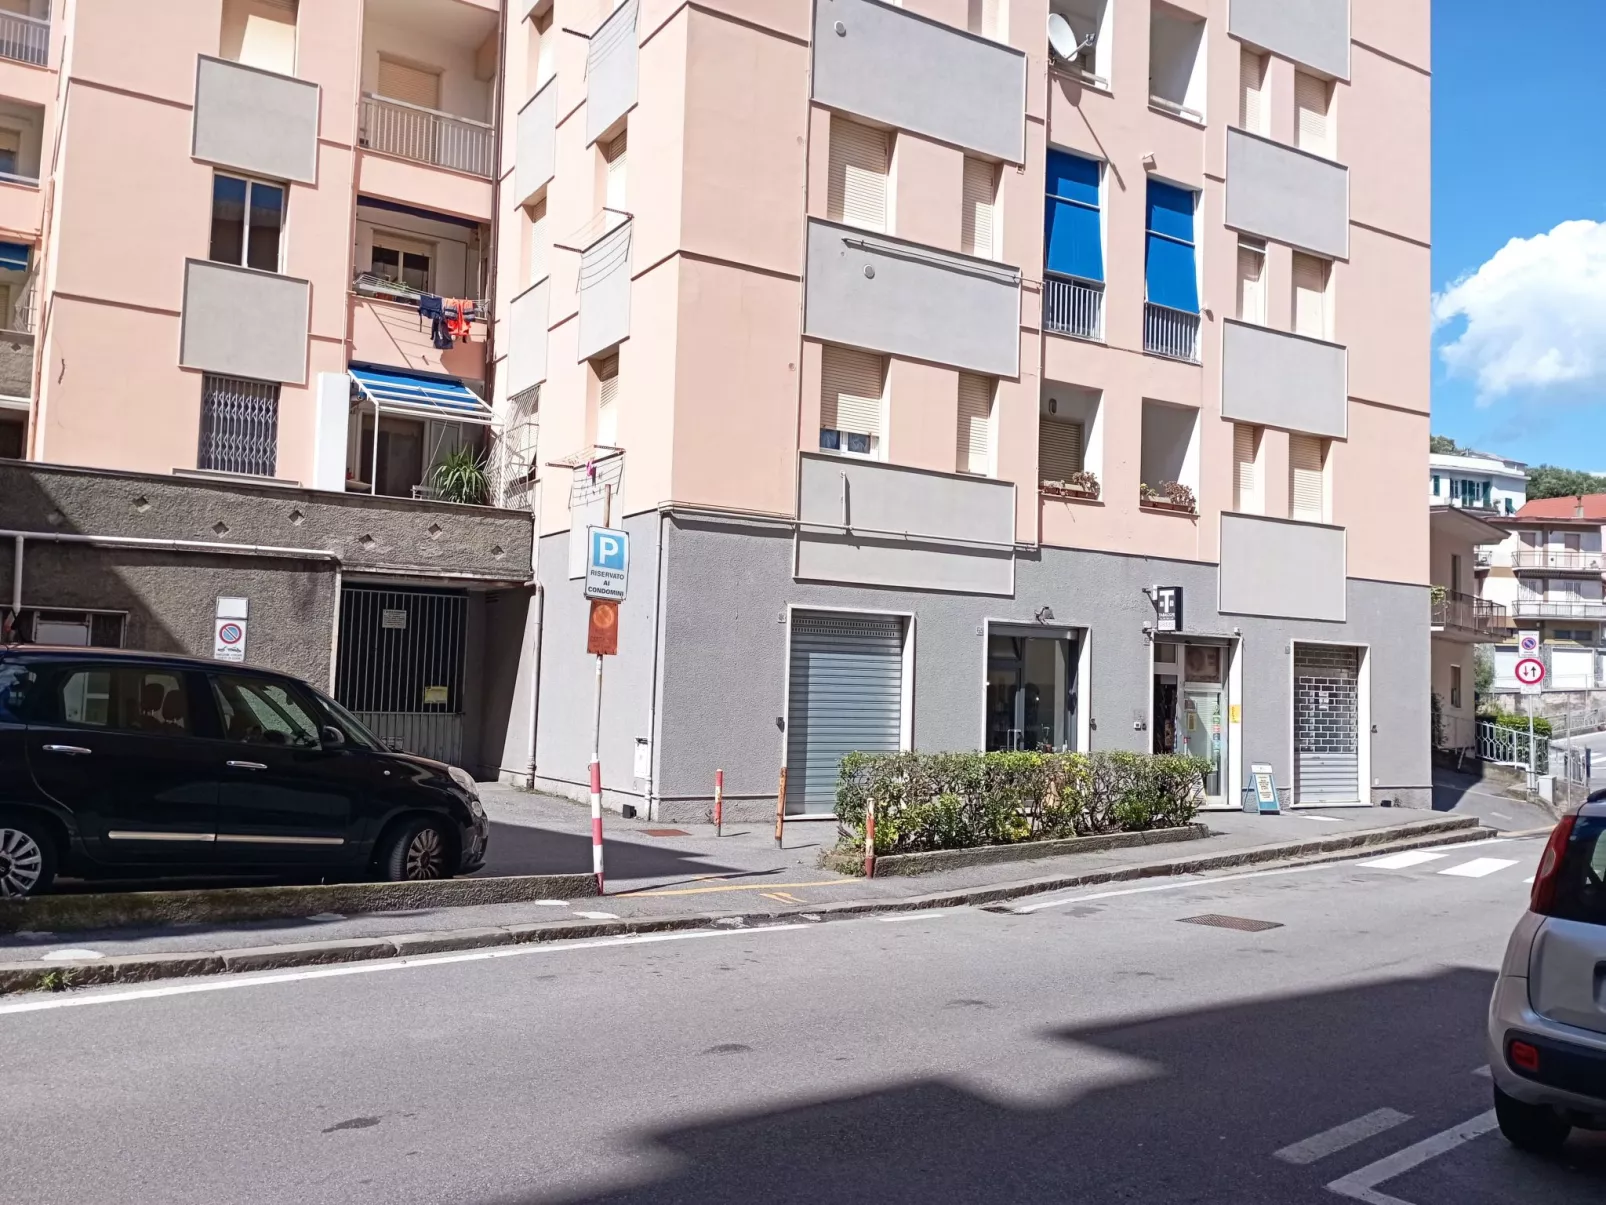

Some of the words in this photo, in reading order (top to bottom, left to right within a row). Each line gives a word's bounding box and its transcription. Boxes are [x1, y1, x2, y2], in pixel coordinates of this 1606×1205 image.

[599, 537, 618, 564] P
[590, 570, 624, 580] RISERVATO
[588, 587, 624, 597] CONDOMINI
